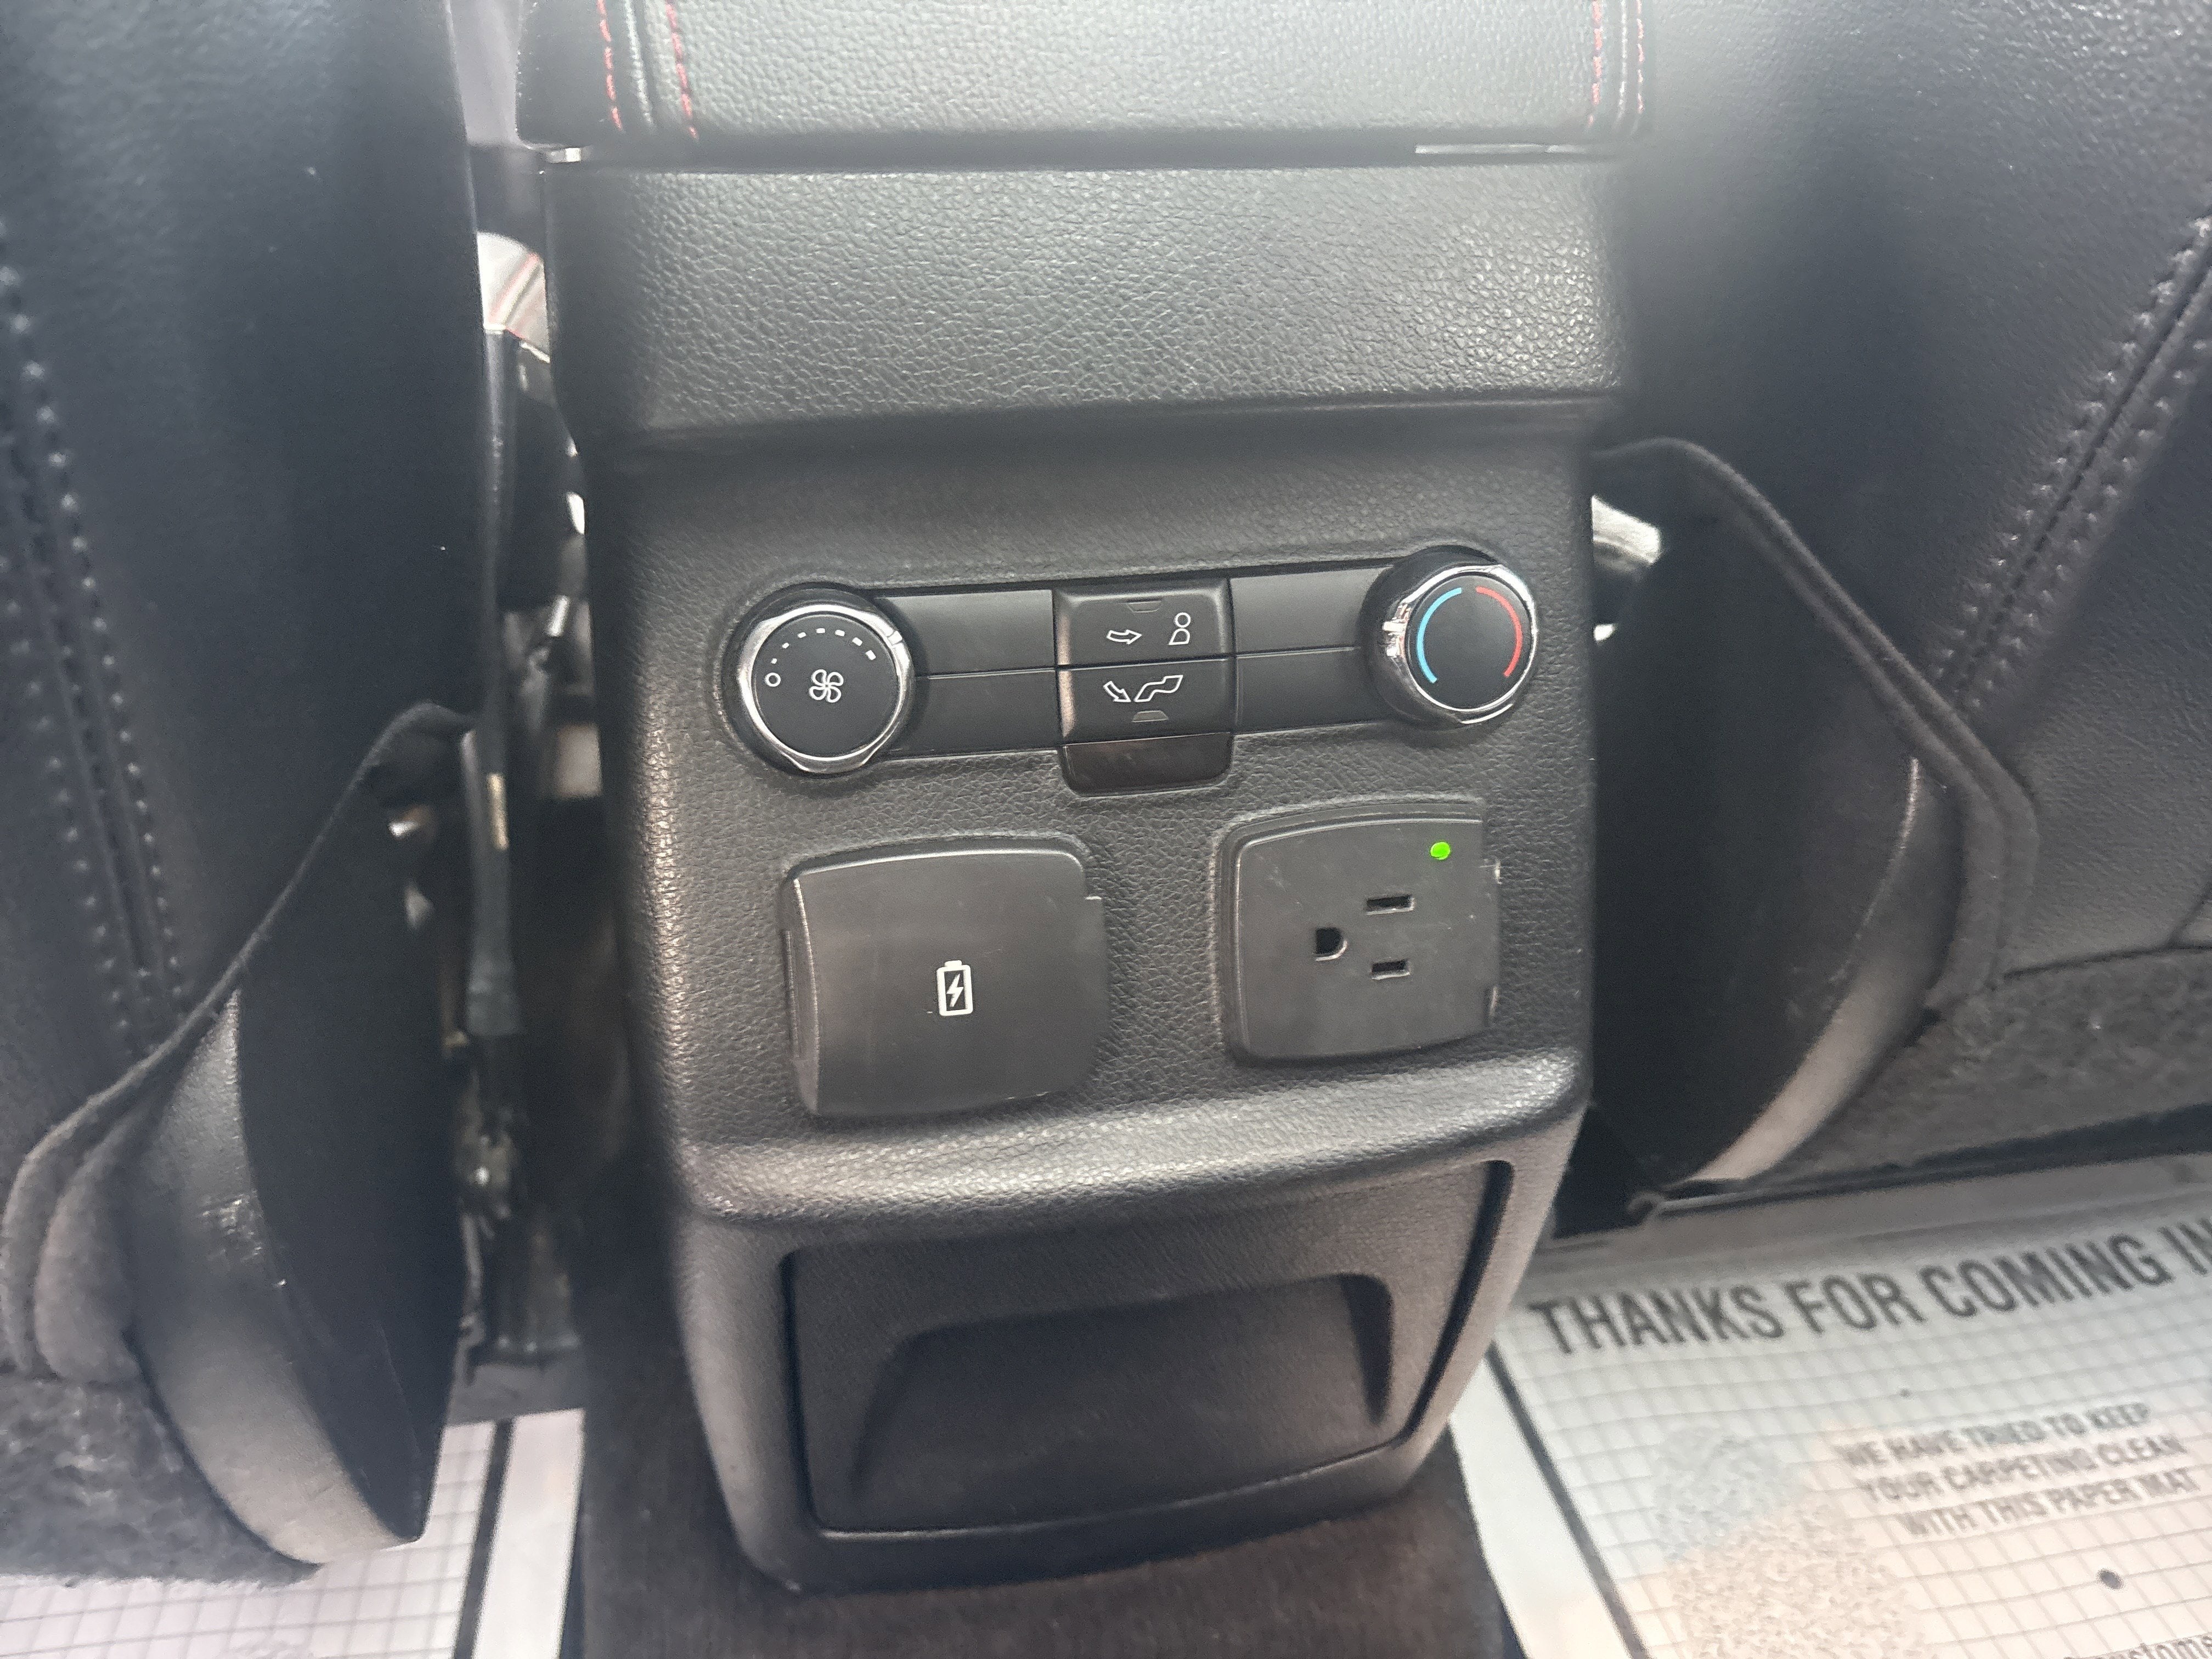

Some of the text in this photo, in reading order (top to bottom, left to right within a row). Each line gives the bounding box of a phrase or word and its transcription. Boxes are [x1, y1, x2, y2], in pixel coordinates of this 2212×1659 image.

[1527, 1285, 1785, 1354] THANKS
[1784, 1272, 1927, 1335] FOR
[1919, 1232, 2175, 1318] COMING
[1831, 1441, 1888, 1468] WE
[1883, 1430, 1966, 1462] HAVE
[2041, 1413, 2087, 1439] TO
[2084, 1402, 2150, 1430] KEEP
[1853, 1433, 2189, 1503] YOUR CARPETING CLEAN
[1894, 1467, 2202, 1537] WITH THIS PAPER MAT
